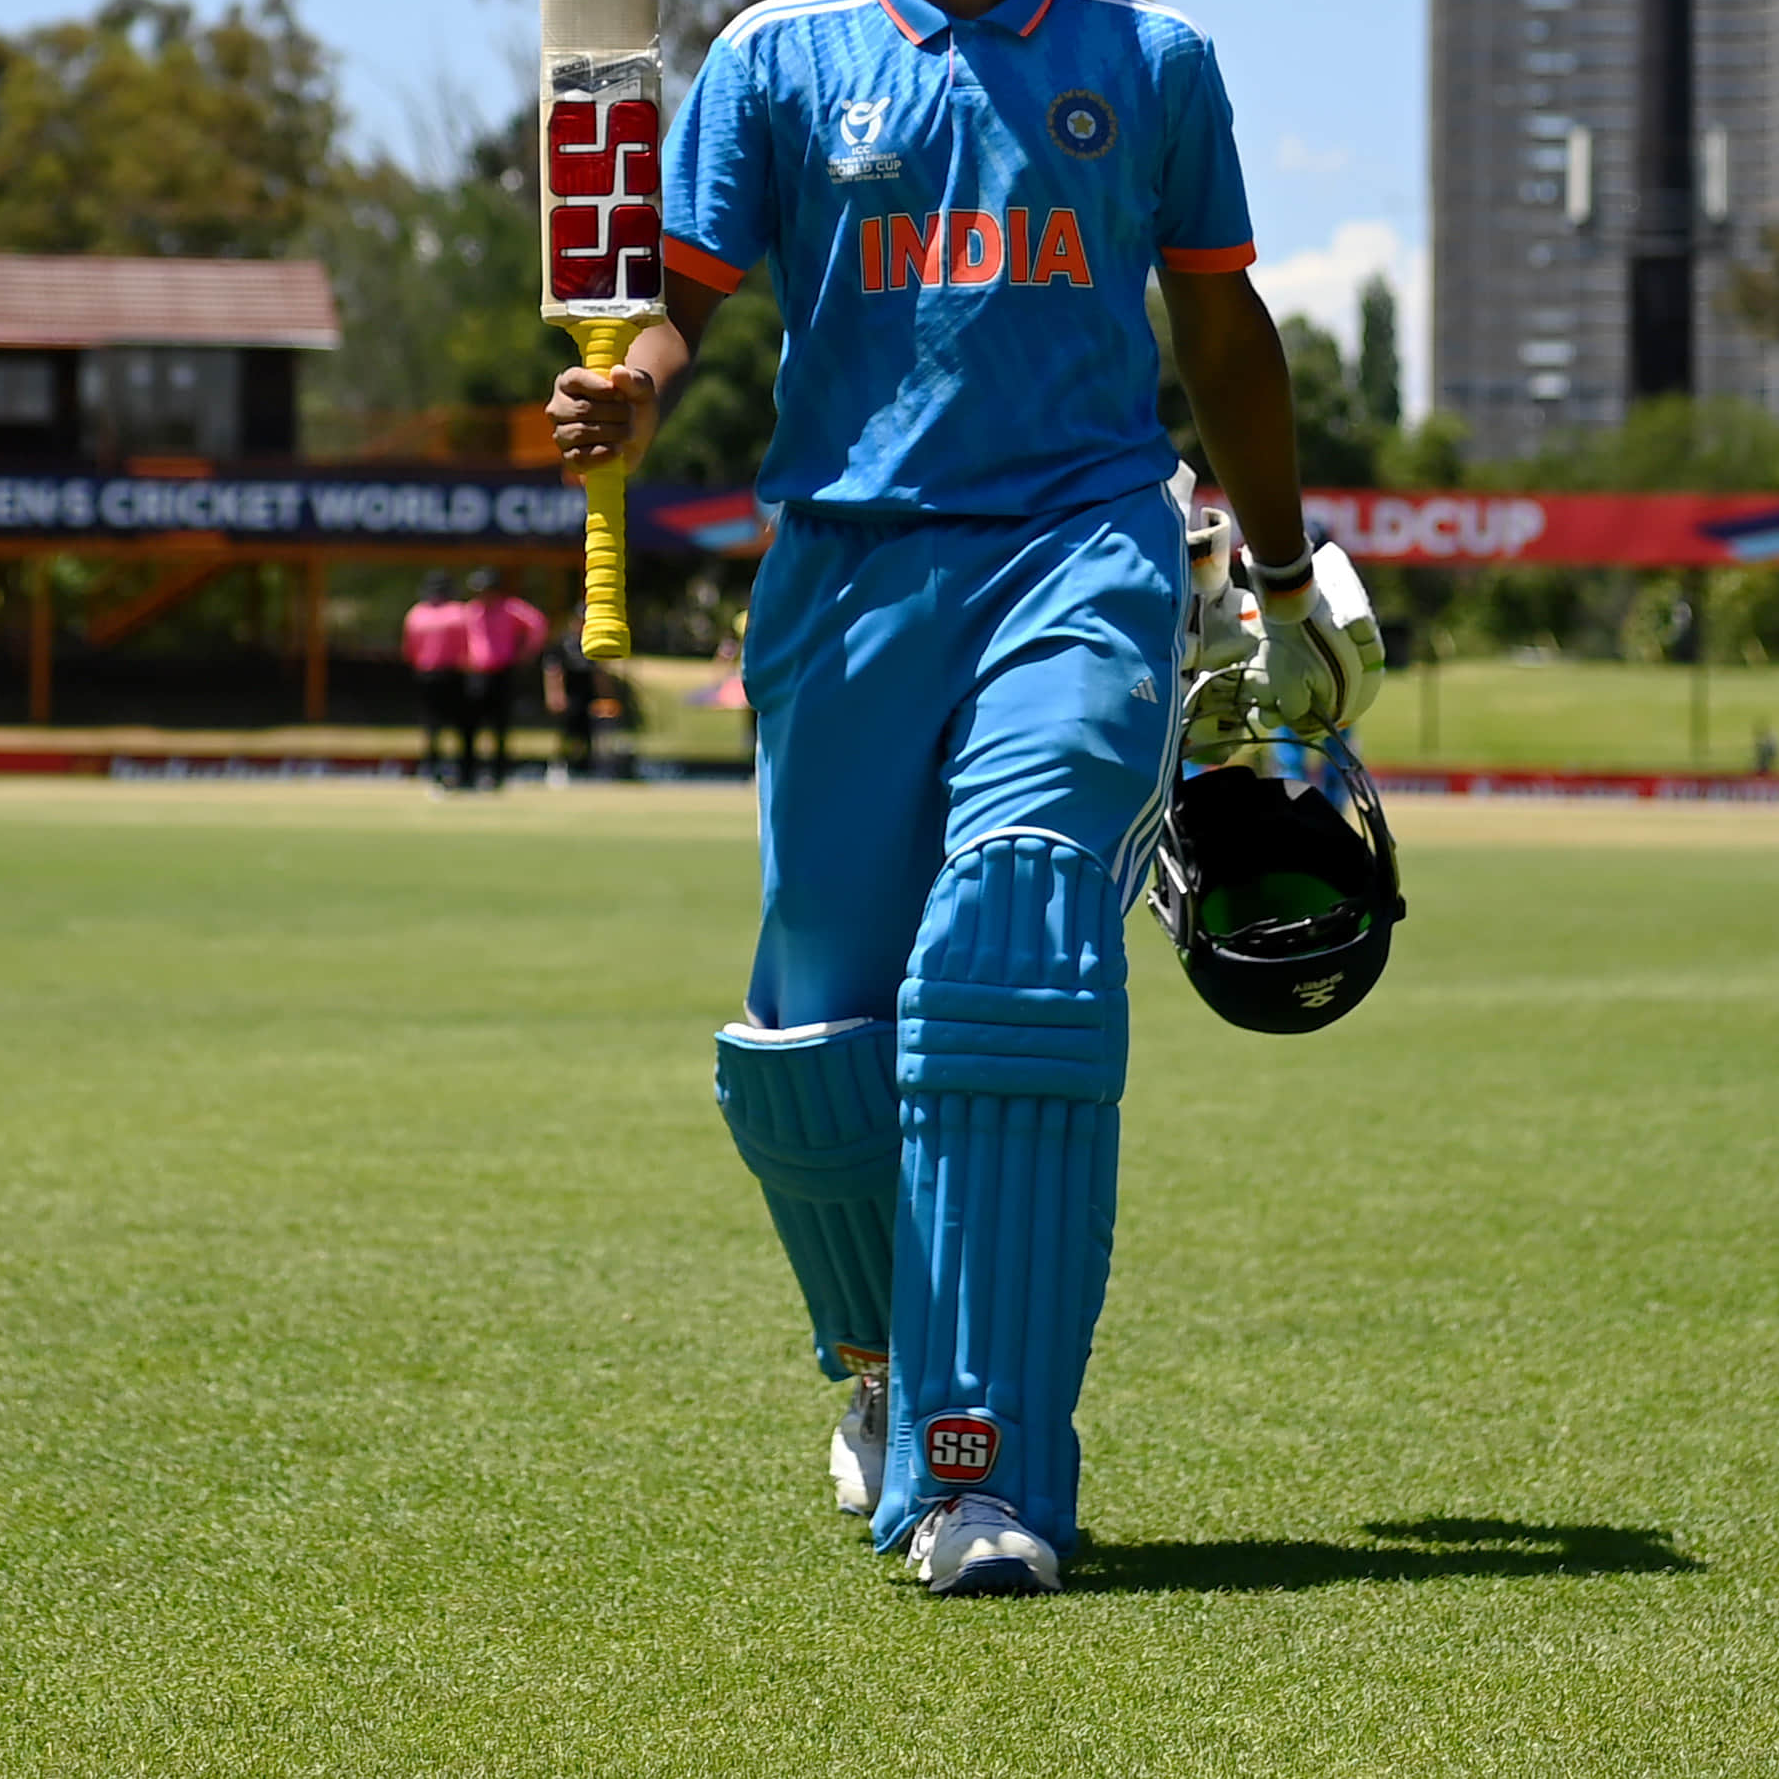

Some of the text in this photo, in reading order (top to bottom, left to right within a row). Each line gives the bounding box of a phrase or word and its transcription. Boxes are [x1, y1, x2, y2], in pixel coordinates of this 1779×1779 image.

[827, 160, 902, 177] WORLD CUP
[851, 144, 871, 156] ICC
[860, 207, 1094, 294] INDIA
[98, 480, 300, 532] CRICKET
[309, 482, 478, 533] WORLD
[931, 1429, 988, 1468] SS
